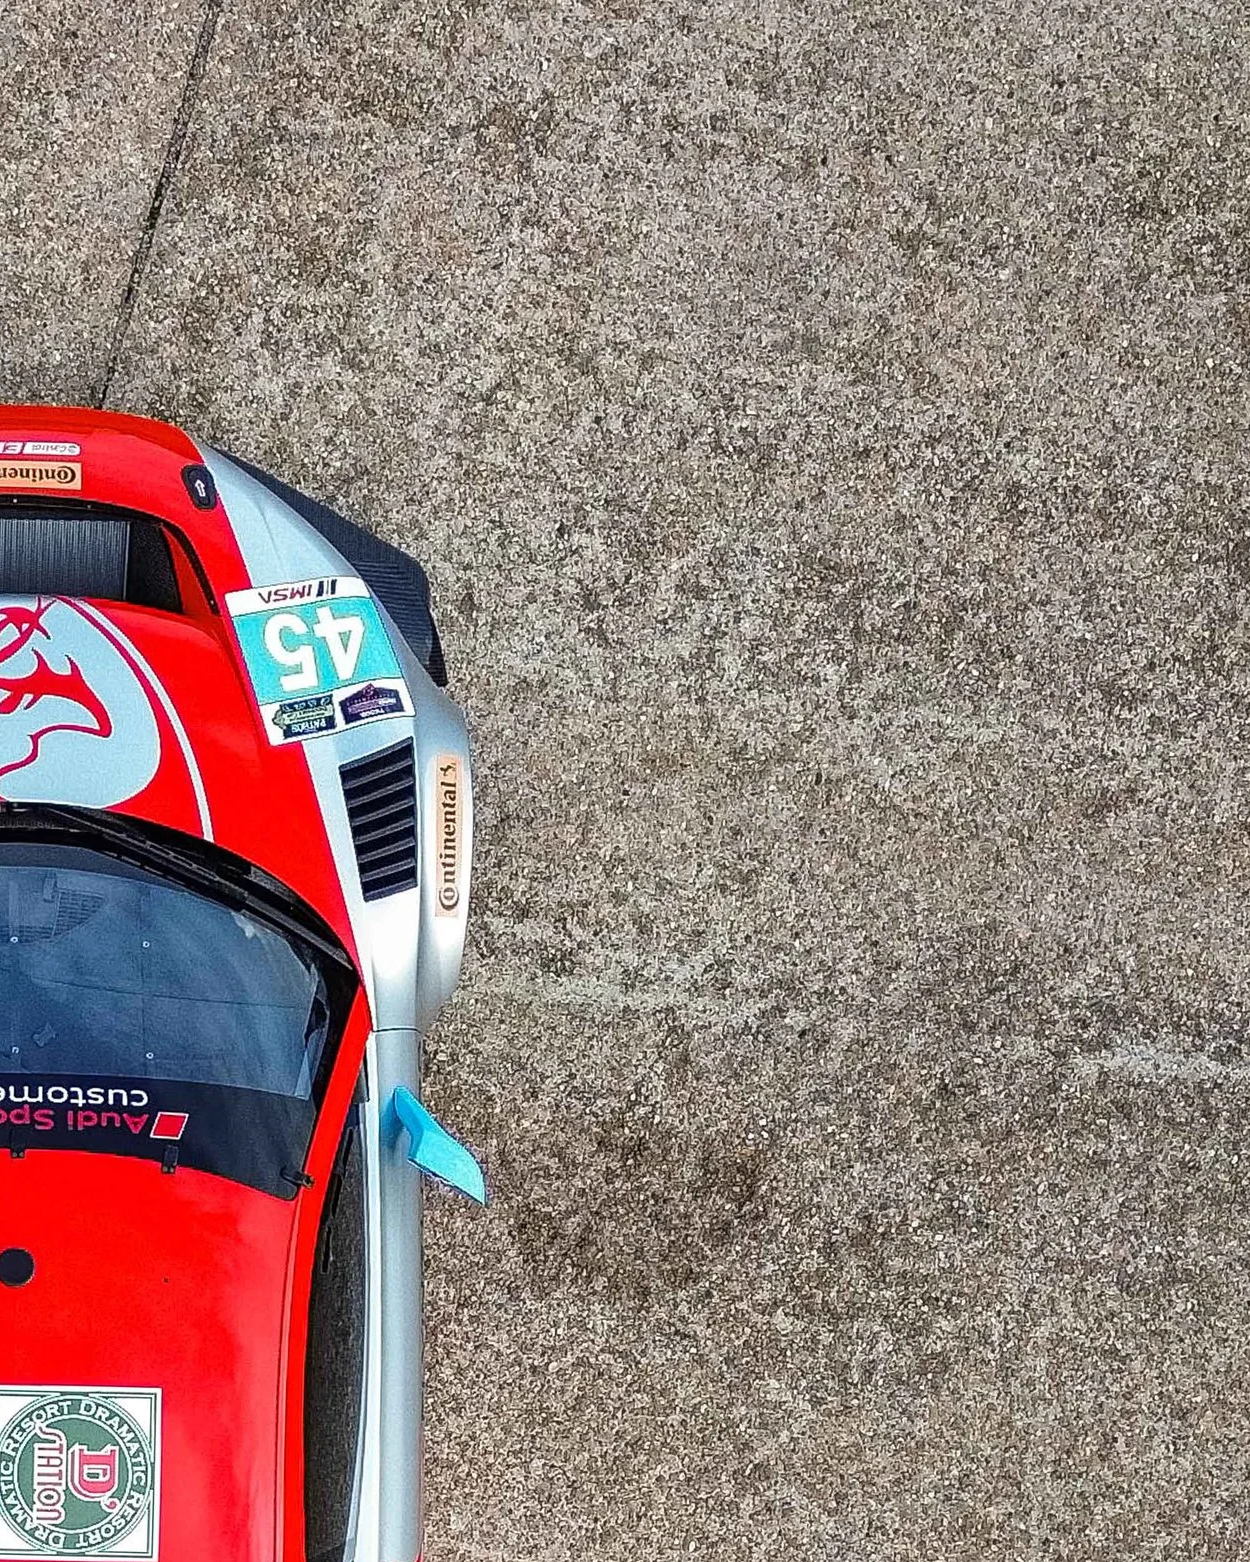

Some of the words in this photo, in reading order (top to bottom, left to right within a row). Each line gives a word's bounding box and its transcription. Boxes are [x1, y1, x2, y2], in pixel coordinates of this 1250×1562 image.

[258, 584, 313, 604] IMSA
[264, 606, 366, 692] 45
[439, 781, 460, 912] Continental
[67, 1110, 149, 1134] Audi
[1, 1400, 72, 1457] RESORT
[78, 1400, 147, 1487] DRAMATIC
[0, 1460, 66, 1548] DRAMATIC
[35, 1424, 67, 1523] STATION
[75, 1490, 145, 1548] RESORT
